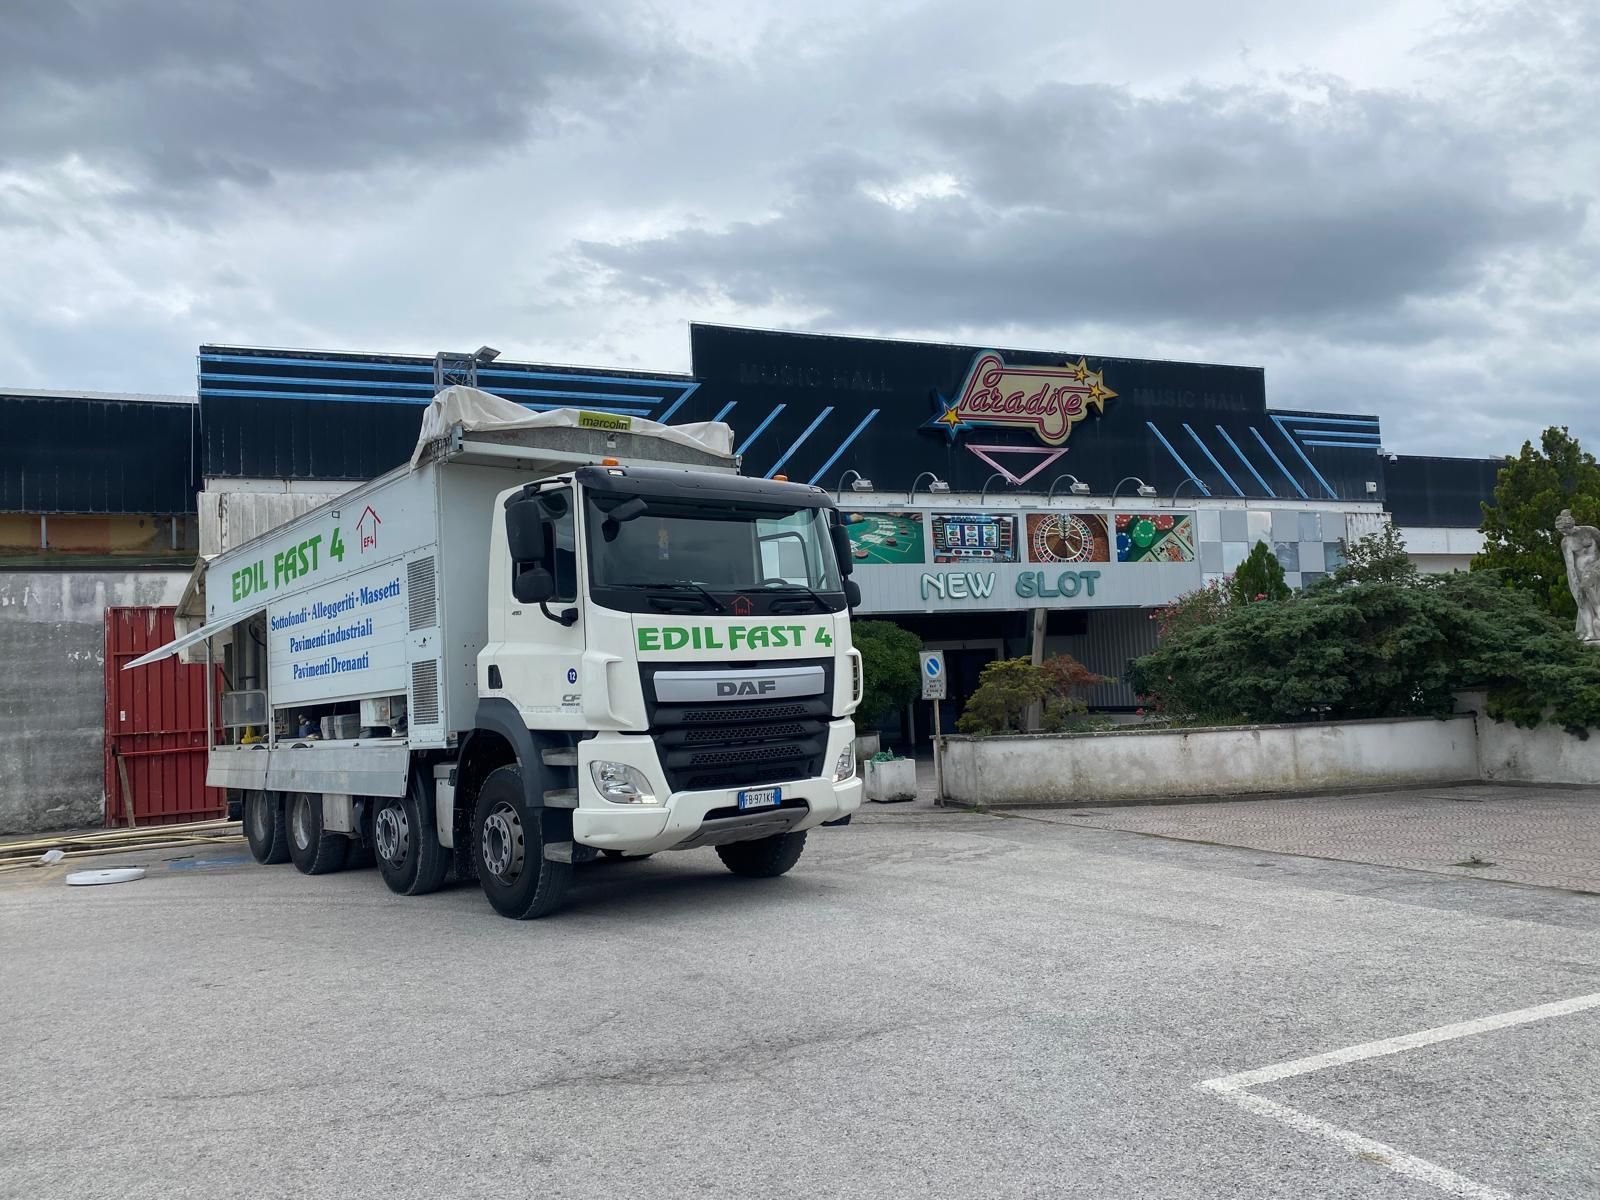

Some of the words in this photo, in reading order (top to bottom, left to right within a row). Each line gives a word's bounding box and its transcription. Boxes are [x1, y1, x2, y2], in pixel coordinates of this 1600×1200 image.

[958, 355, 1084, 439] Paradise
[582, 417, 628, 430] marcolin
[363, 535, 374, 548] EF4
[232, 559, 269, 603] EDIL
[274, 534, 322, 591] FAST
[330, 527, 345, 562] 4
[921, 572, 996, 600] NEW
[1015, 571, 1102, 598] SLOT
[271, 607, 307, 631] Sottofondi
[312, 591, 355, 619] Alleggeriti
[360, 577, 400, 606] Massetti
[290, 629, 326, 653] Pavimenti
[327, 617, 373, 645] industriali
[637, 627, 723, 651] EDIL
[728, 626, 806, 650] FAST
[814, 627, 833, 648] 4
[293, 658, 330, 680] Pavimenti
[331, 651, 369, 674] Drenanti
[568, 671, 576, 681] 12
[716, 680, 776, 697] DAF
